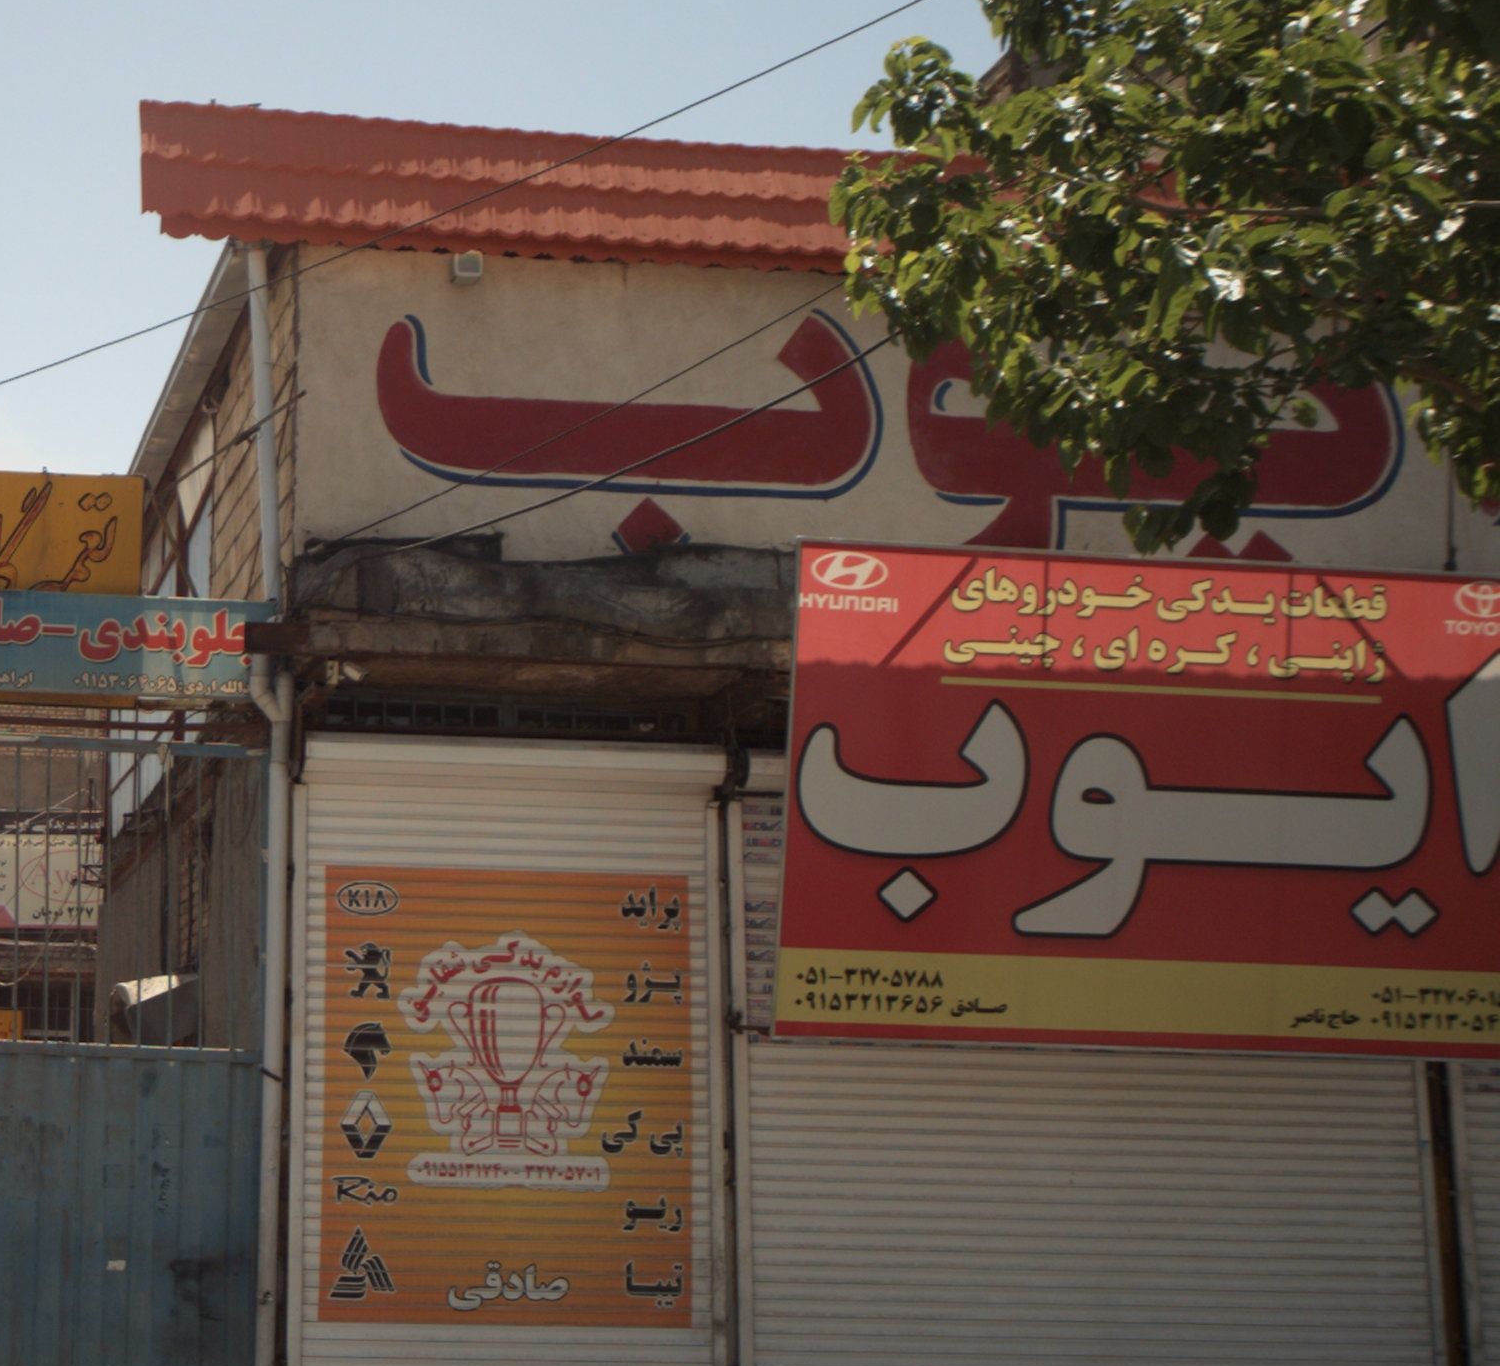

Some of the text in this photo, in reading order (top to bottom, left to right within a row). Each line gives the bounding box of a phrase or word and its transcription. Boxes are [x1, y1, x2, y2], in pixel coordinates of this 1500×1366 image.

[798, 592, 899, 614] HYUNDAI
[950, 566, 1388, 625] قطعات یدکی خودروهای
[1442, 619, 1500, 637] TOYO
[943, 626, 1388, 684] ژاپنی کره ای چینی
[348, 889, 388, 909] KIA
[621, 885, 681, 931] پراید
[622, 962, 683, 1005] پژو
[949, 997, 1008, 1017] صادق
[622, 1037, 684, 1067] سمند
[333, 1175, 399, 1206] Rio
[622, 1195, 683, 1232] ریو
[447, 1261, 570, 1311] صادقی
[625, 1259, 684, 1307] تیبا
